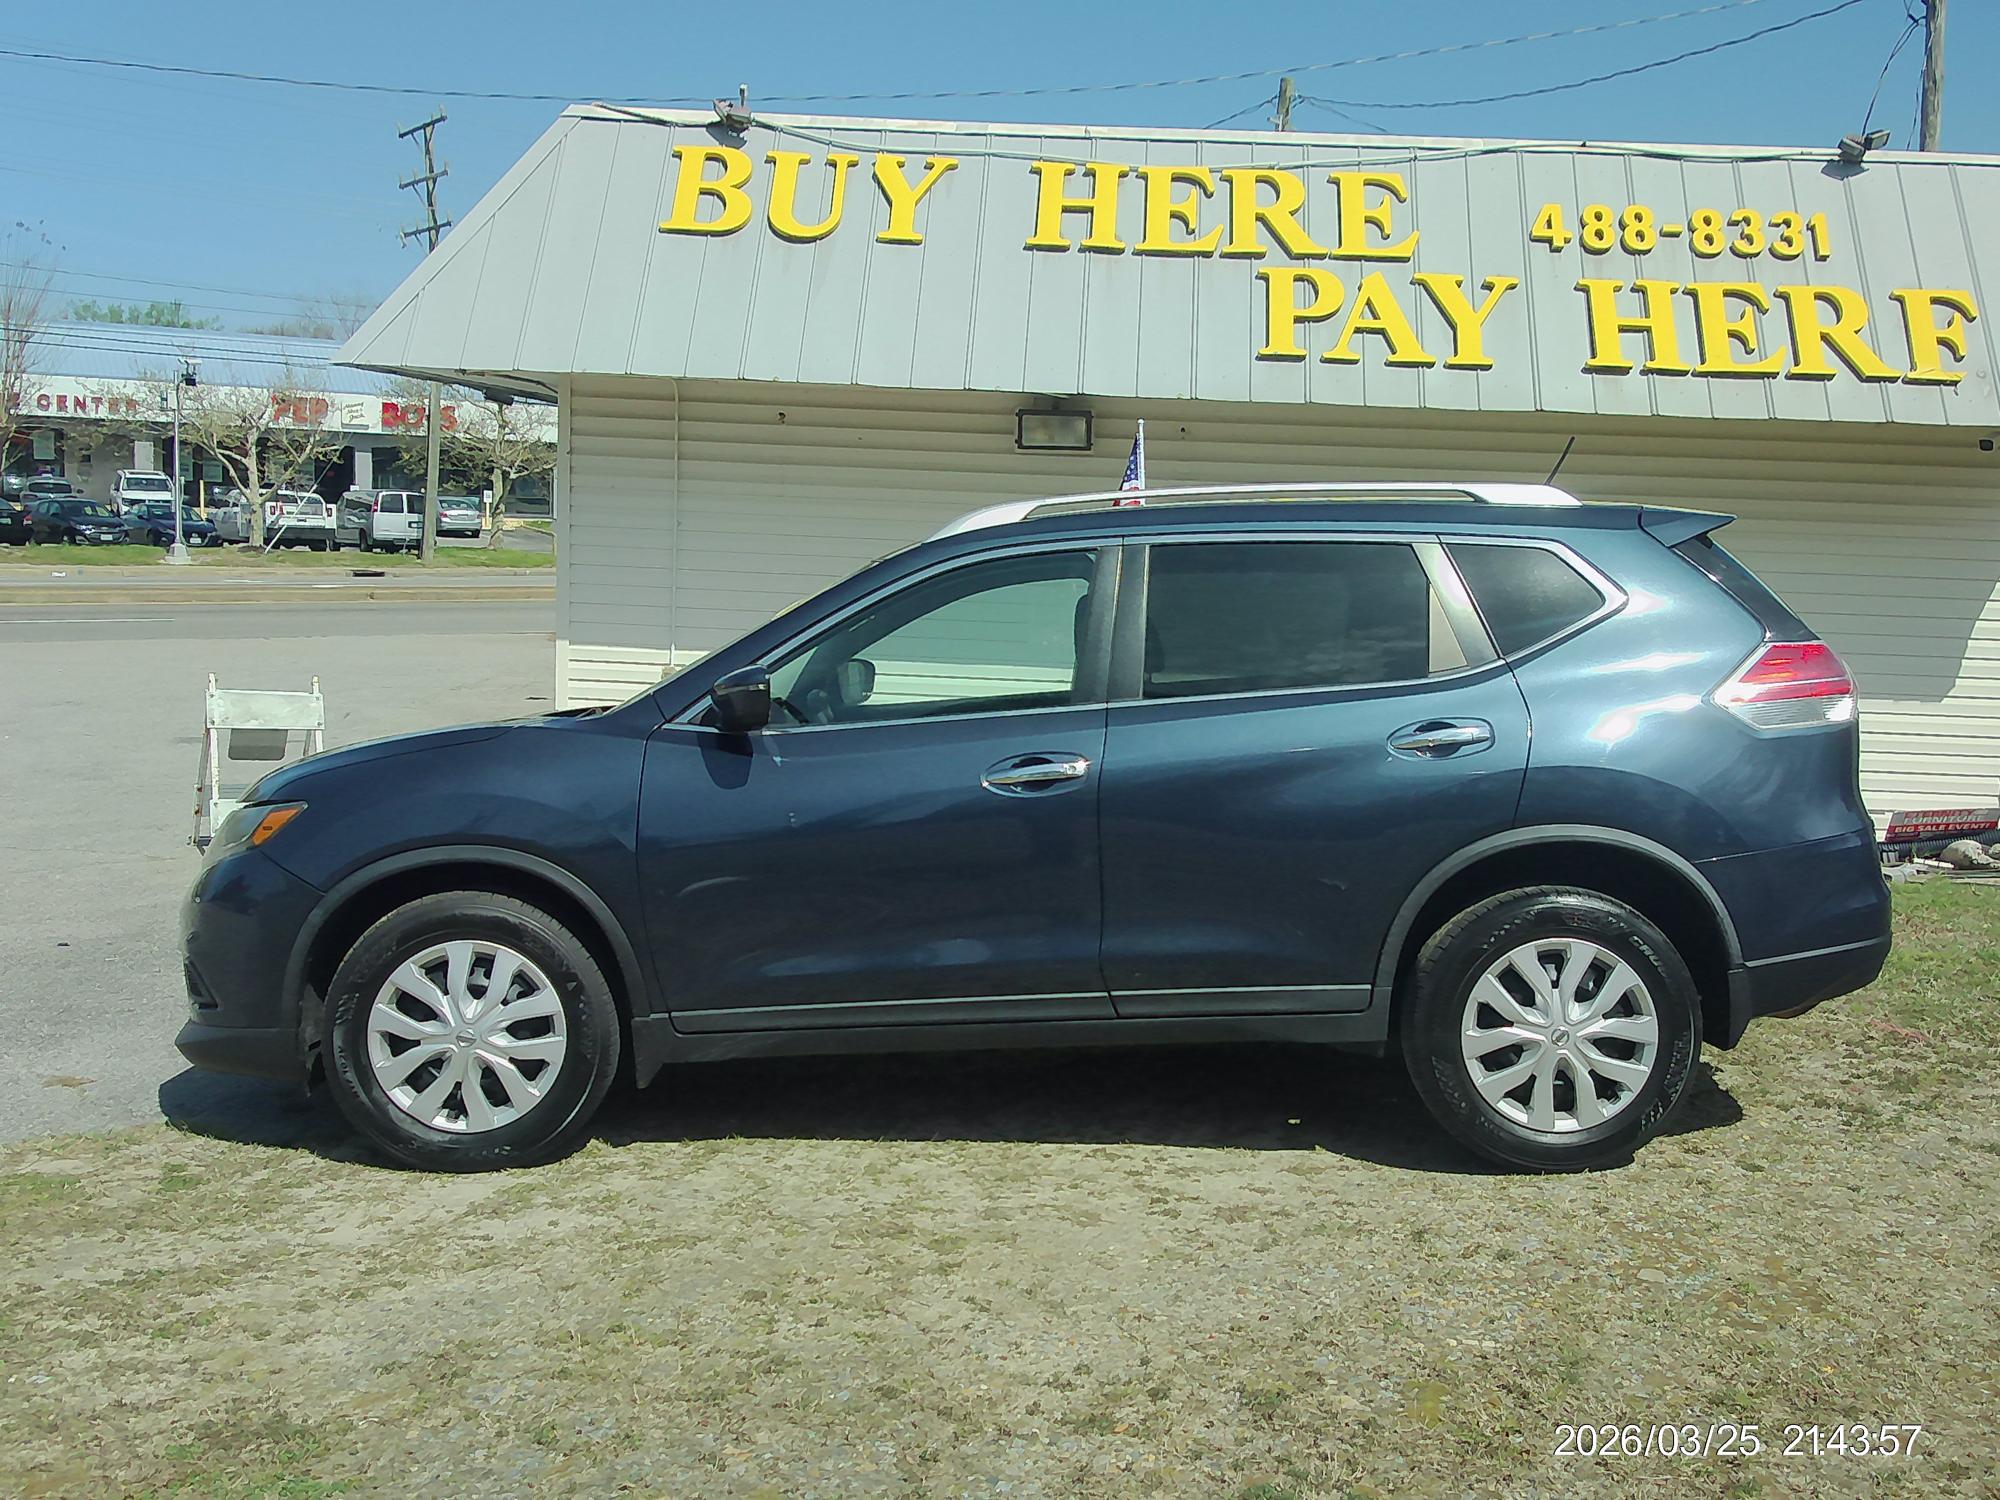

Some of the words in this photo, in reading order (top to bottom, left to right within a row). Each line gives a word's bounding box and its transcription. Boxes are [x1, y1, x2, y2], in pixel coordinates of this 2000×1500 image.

[660, 146, 959, 243] BUY
[1026, 160, 1420, 258] HERE
[1531, 203, 1831, 259] 488-8331
[1258, 267, 1518, 368] PAY
[381, 402, 458, 432] BOS
[1917, 824, 1946, 832] SALE
